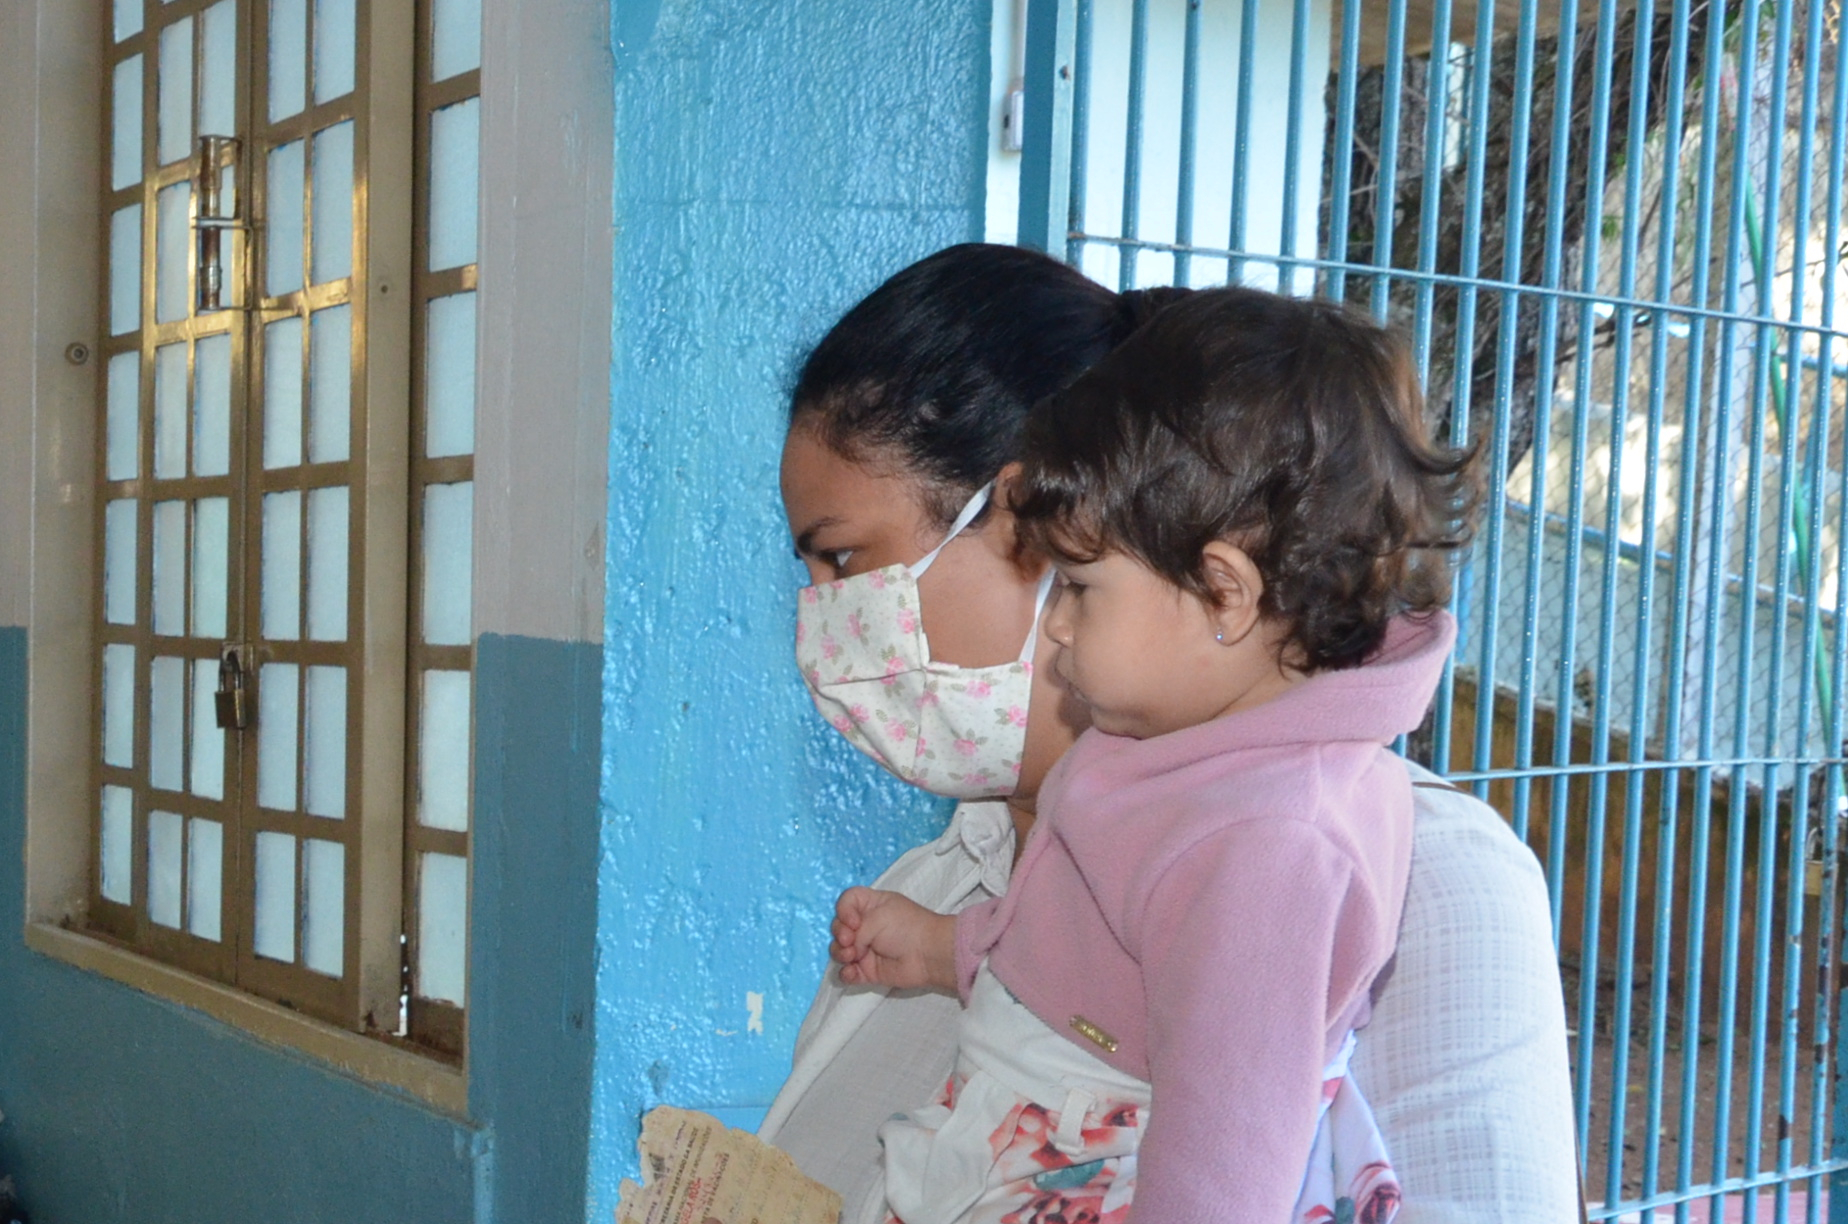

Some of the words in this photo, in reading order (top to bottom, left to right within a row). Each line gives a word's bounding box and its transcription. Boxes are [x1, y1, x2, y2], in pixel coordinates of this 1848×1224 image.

[672, 1159, 687, 1185] ESTADO
[689, 1169, 696, 1178] DE
[669, 1185, 677, 1194] DE
[705, 1195, 714, 1206] DE
